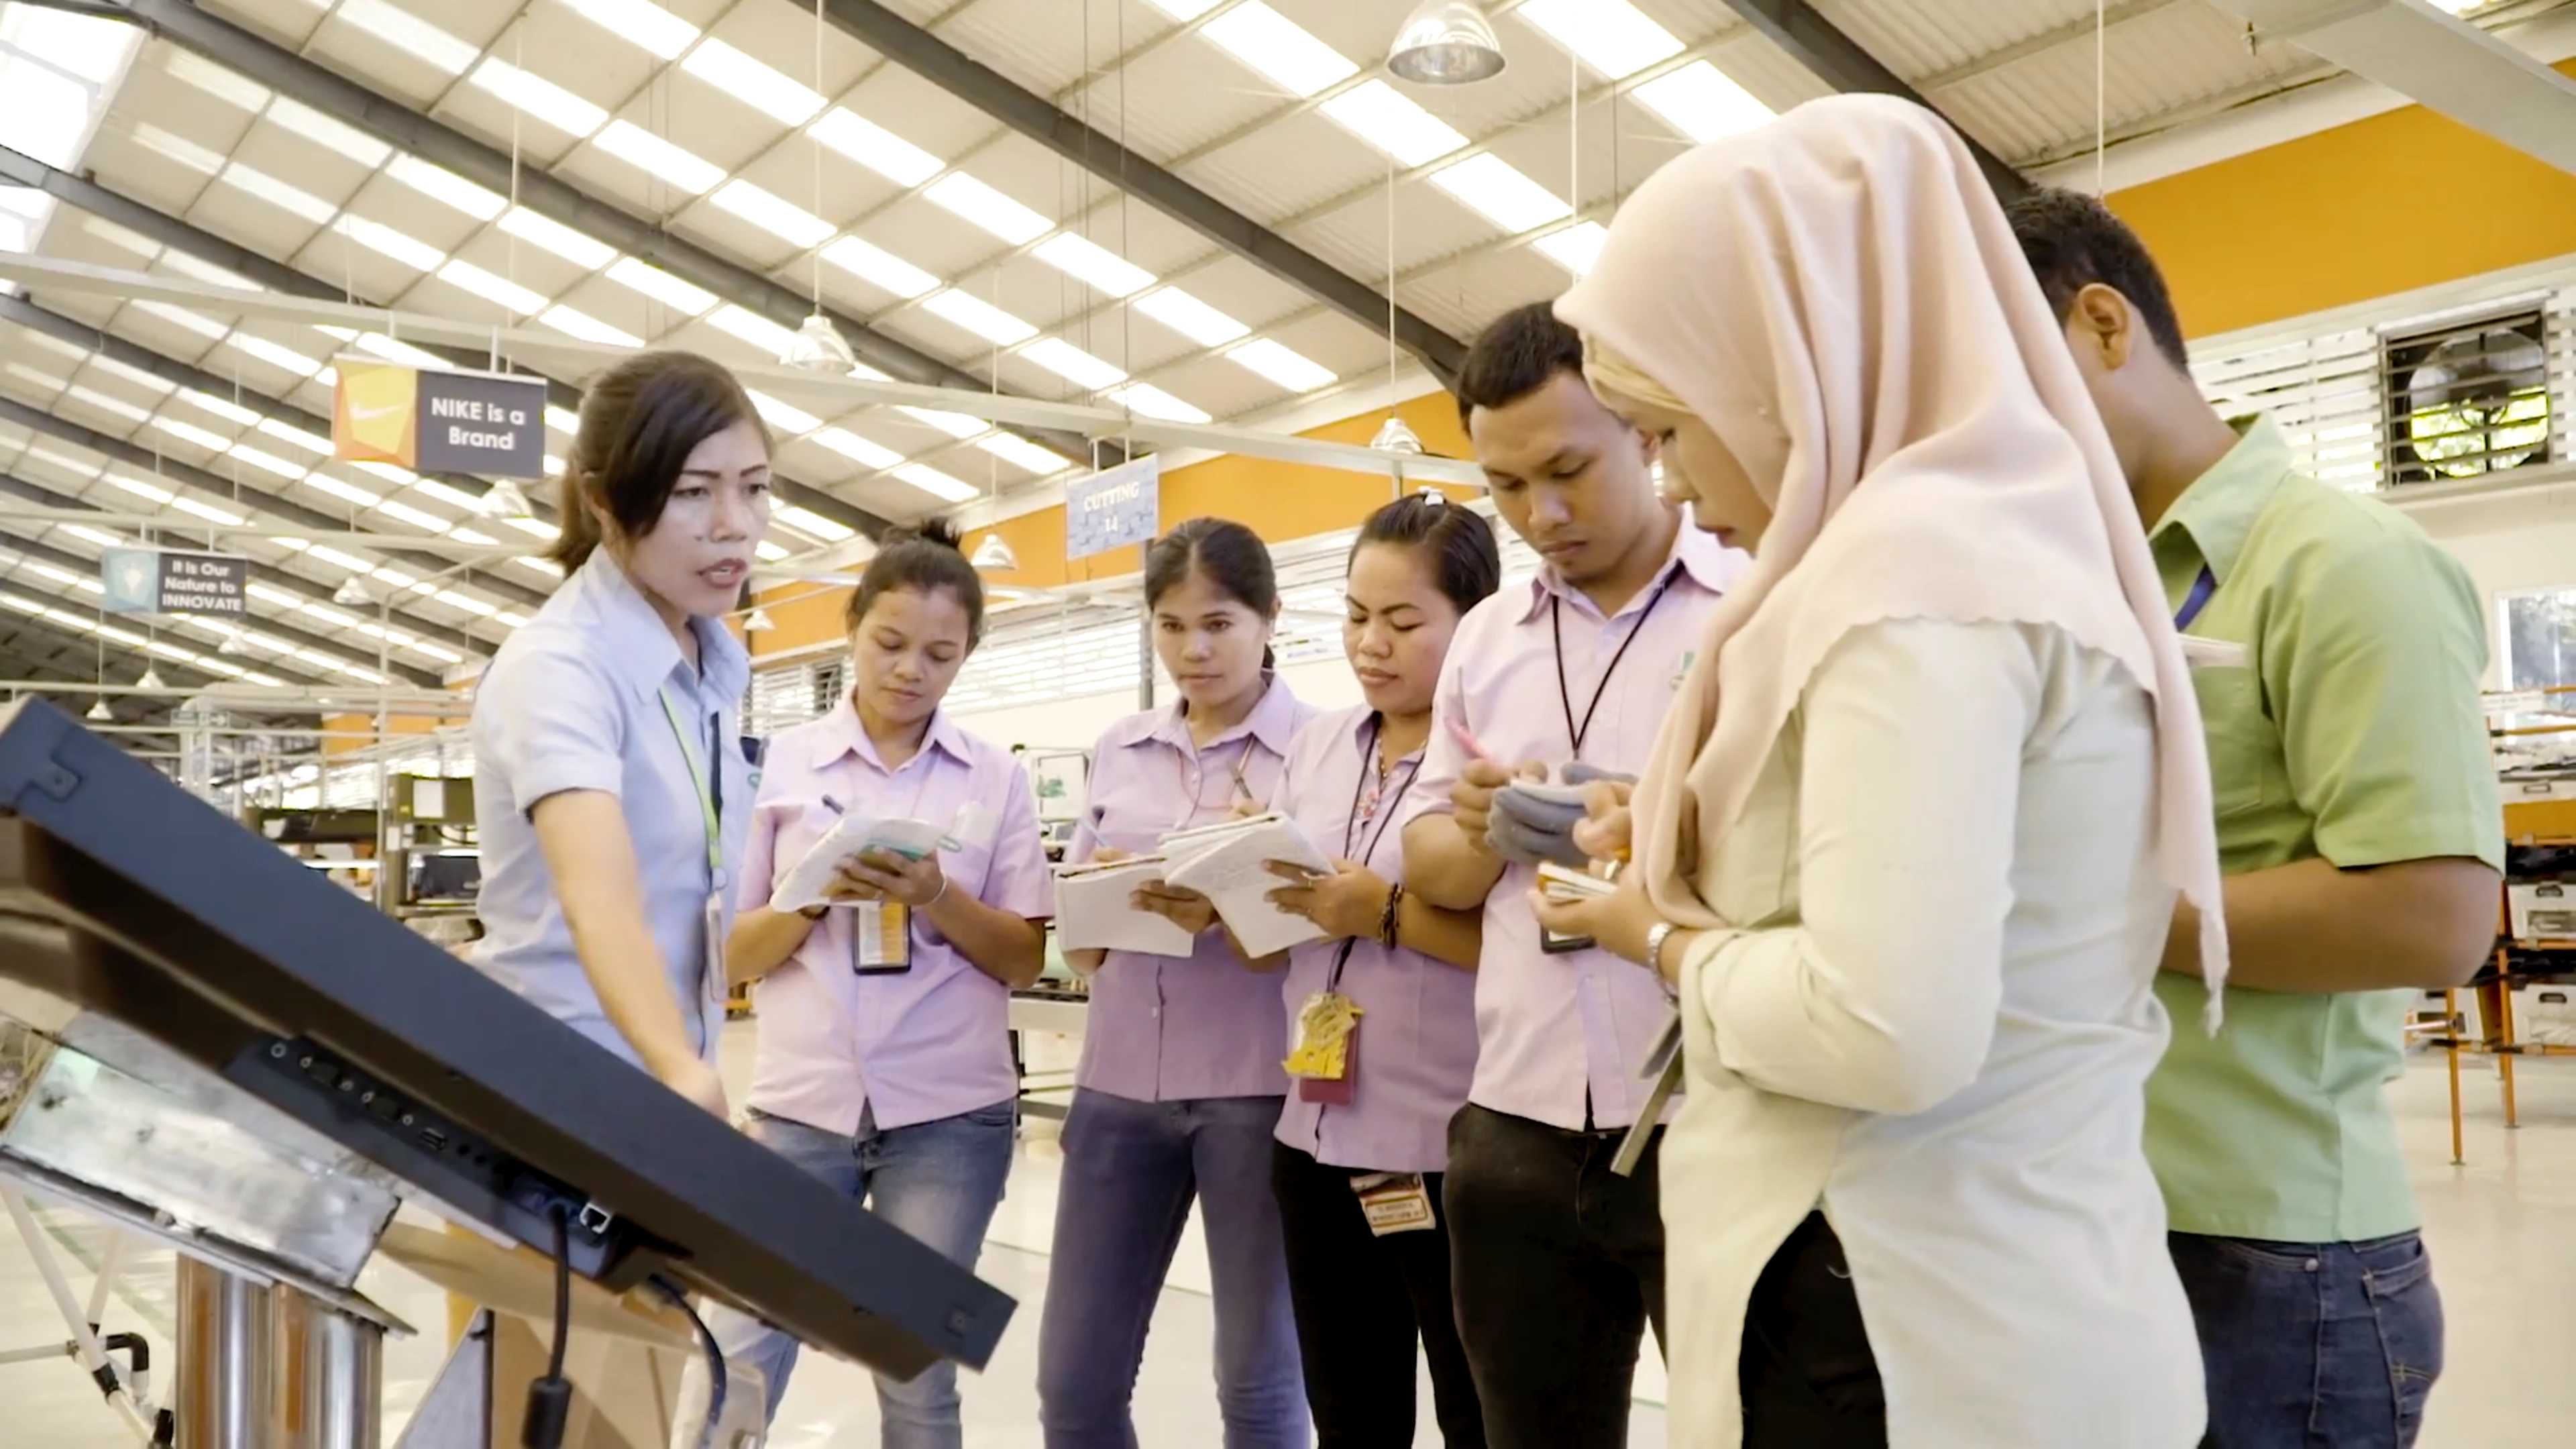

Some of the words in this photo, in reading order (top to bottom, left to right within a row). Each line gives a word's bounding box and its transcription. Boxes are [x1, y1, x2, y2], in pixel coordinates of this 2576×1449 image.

[431, 397, 482, 421] NIKE
[488, 403, 504, 423] is
[510, 410, 525, 425] a
[449, 426, 515, 450] Brand
[1084, 482, 1139, 512] CUTTING
[172, 560, 182, 572] It
[201, 564, 230, 577] Our
[165, 577, 217, 592] Nature
[221, 582, 236, 594] to
[162, 594, 242, 611] INNOVATE
